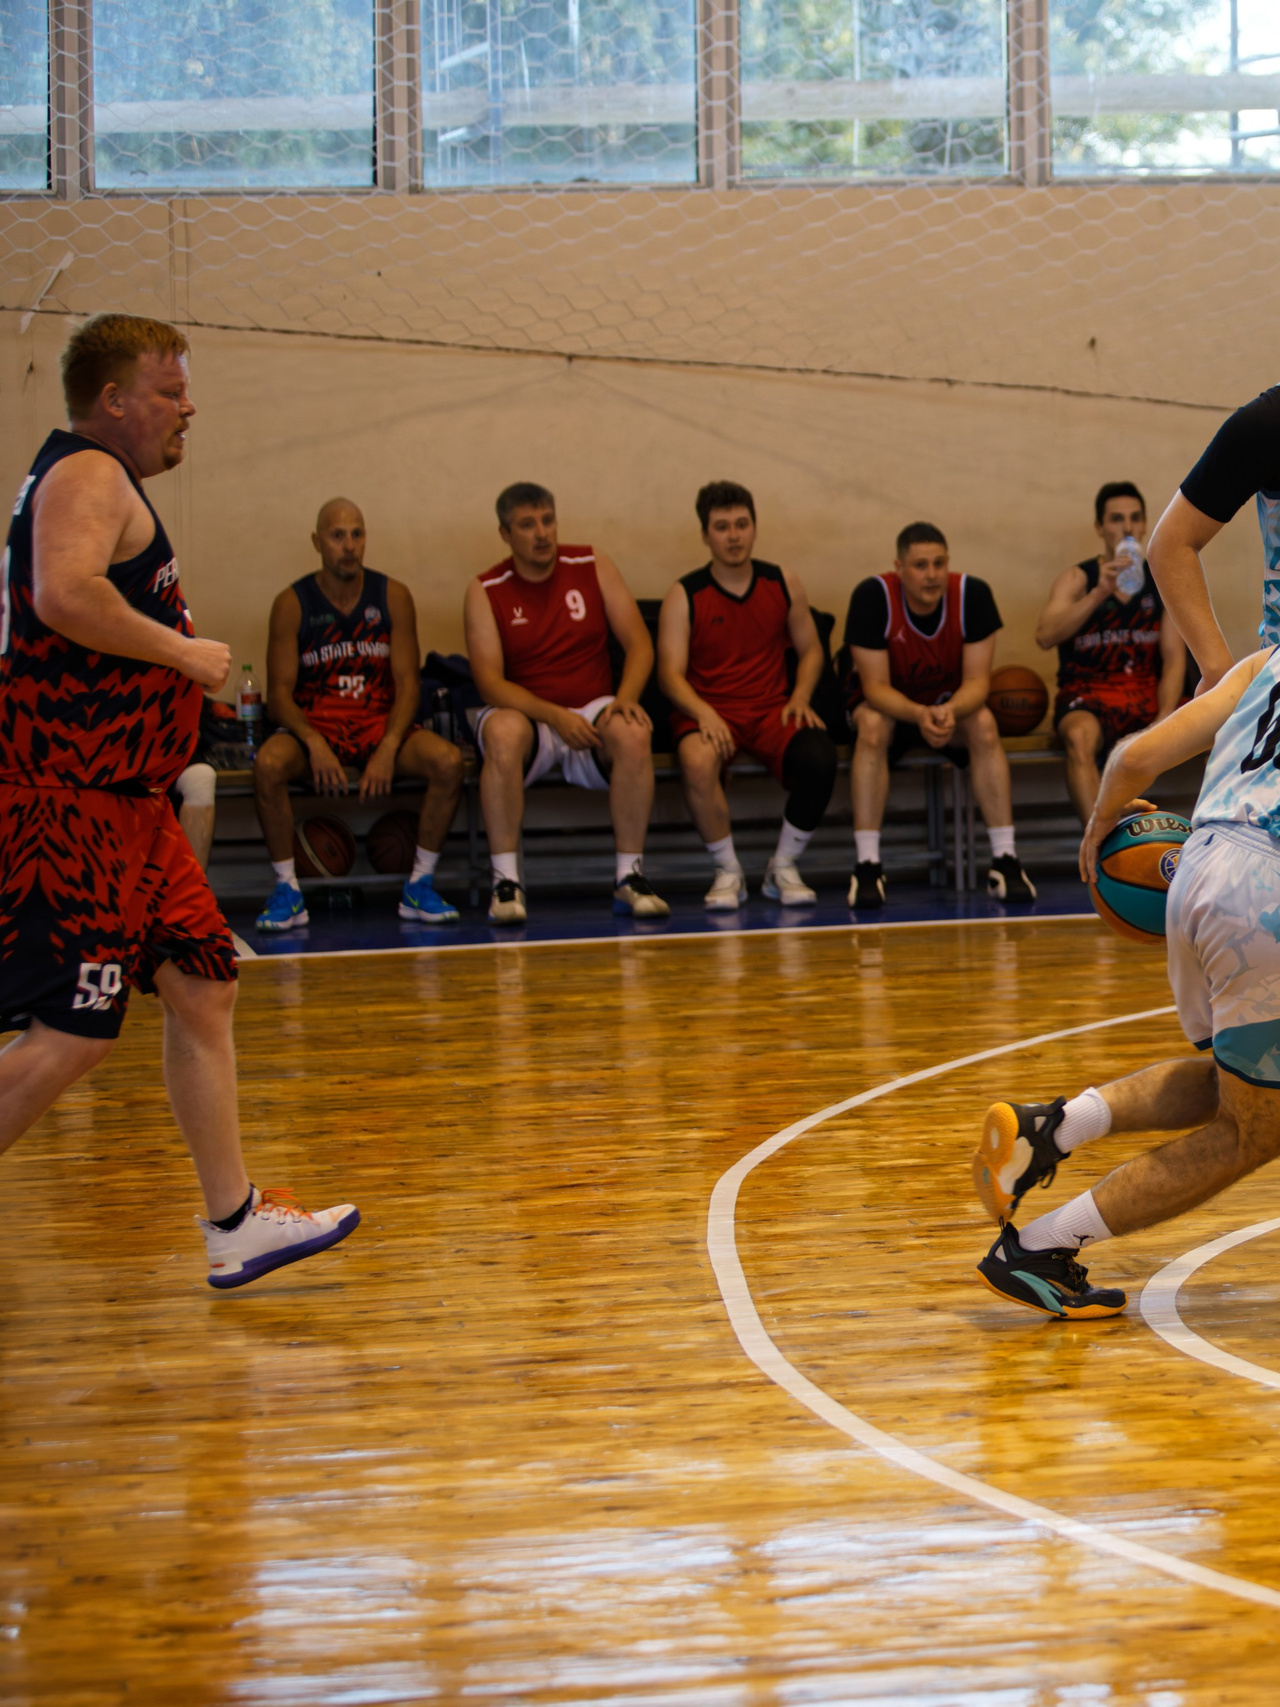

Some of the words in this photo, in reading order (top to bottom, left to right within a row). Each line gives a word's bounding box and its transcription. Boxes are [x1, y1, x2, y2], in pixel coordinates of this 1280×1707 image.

[565, 588, 586, 622] 9
[320, 641, 355, 664] STATE
[71, 962, 122, 1010] 59
